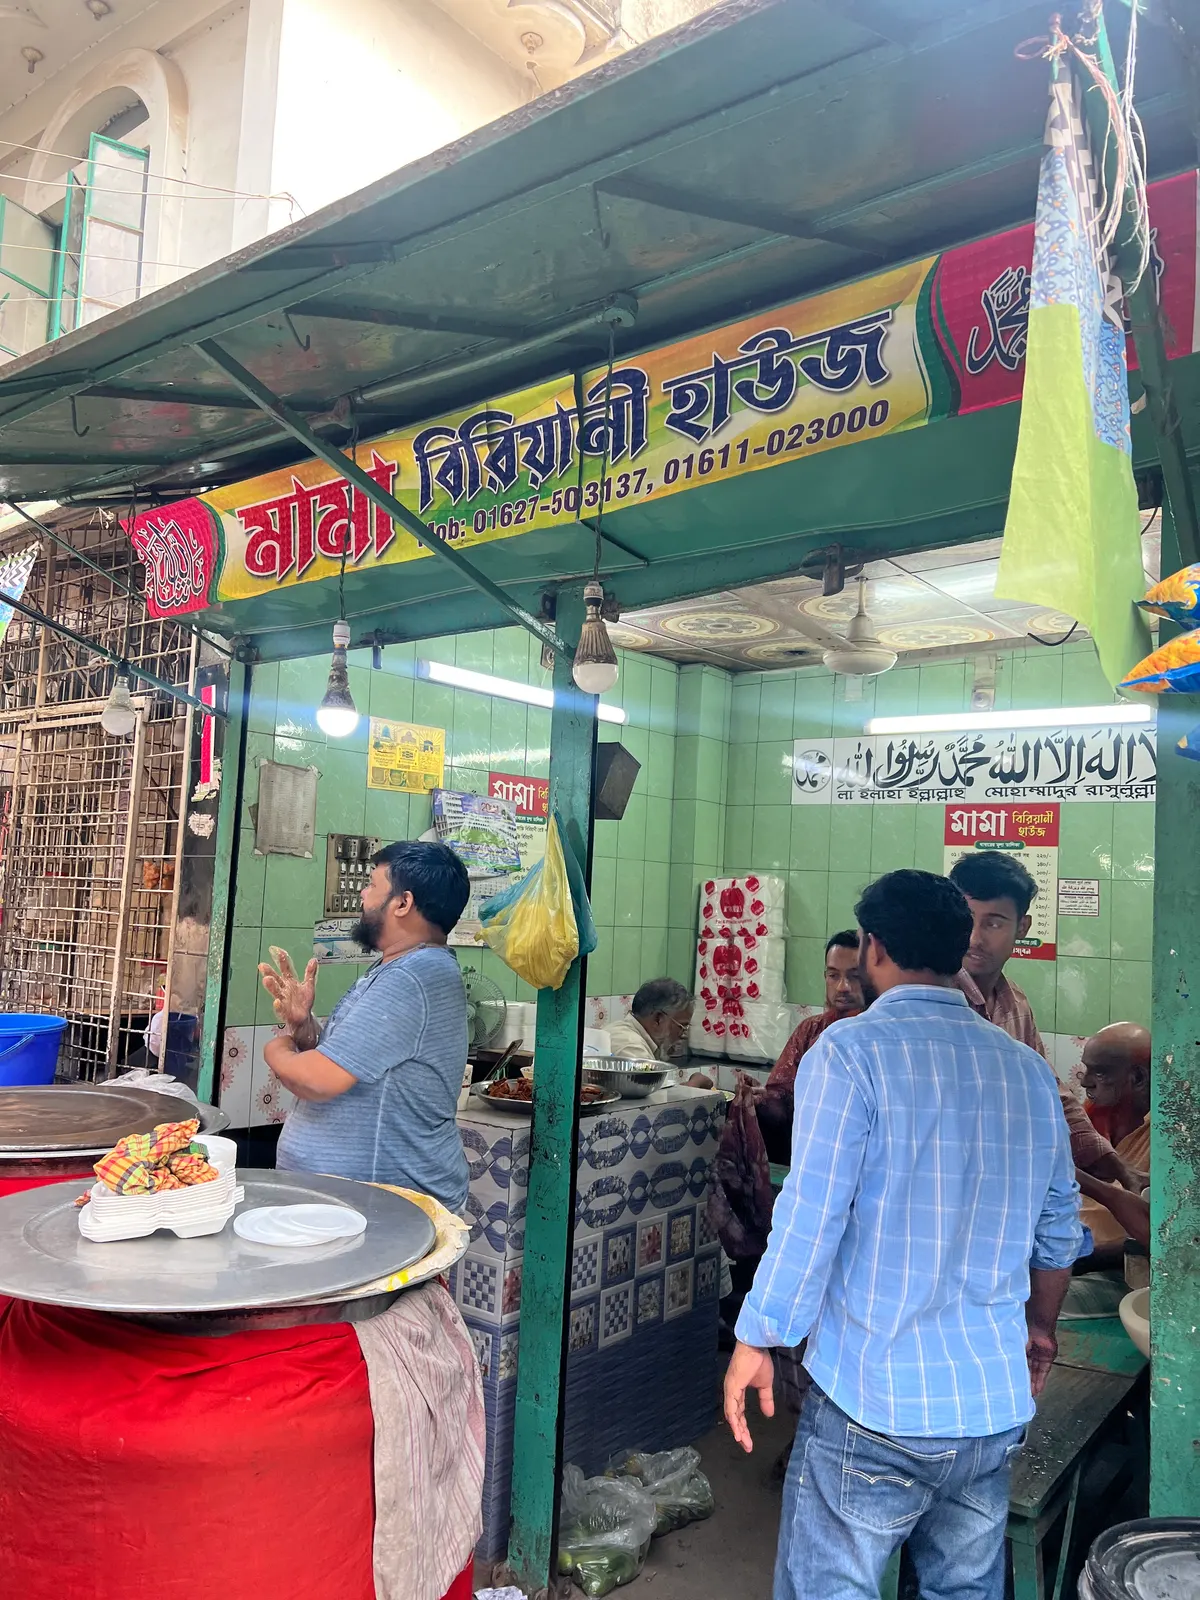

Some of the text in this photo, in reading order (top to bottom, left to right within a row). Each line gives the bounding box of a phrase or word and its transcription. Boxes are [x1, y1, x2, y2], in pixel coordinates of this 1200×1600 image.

[235, 308, 893, 582] মামা বিরিয়ানী হাউজ
[473, 468, 654, 534] 01627-503137,
[662, 399, 891, 485] 01611-023000
[492, 780, 536, 811] মামা
[837, 790, 855, 800] লা
[1083, 784, 1157, 799] রাসুলুল্লা
[949, 809, 1009, 837] মামা
[1012, 810, 1054, 825] বিরিয়ানী
[1018, 826, 1047, 838] হাউজ
